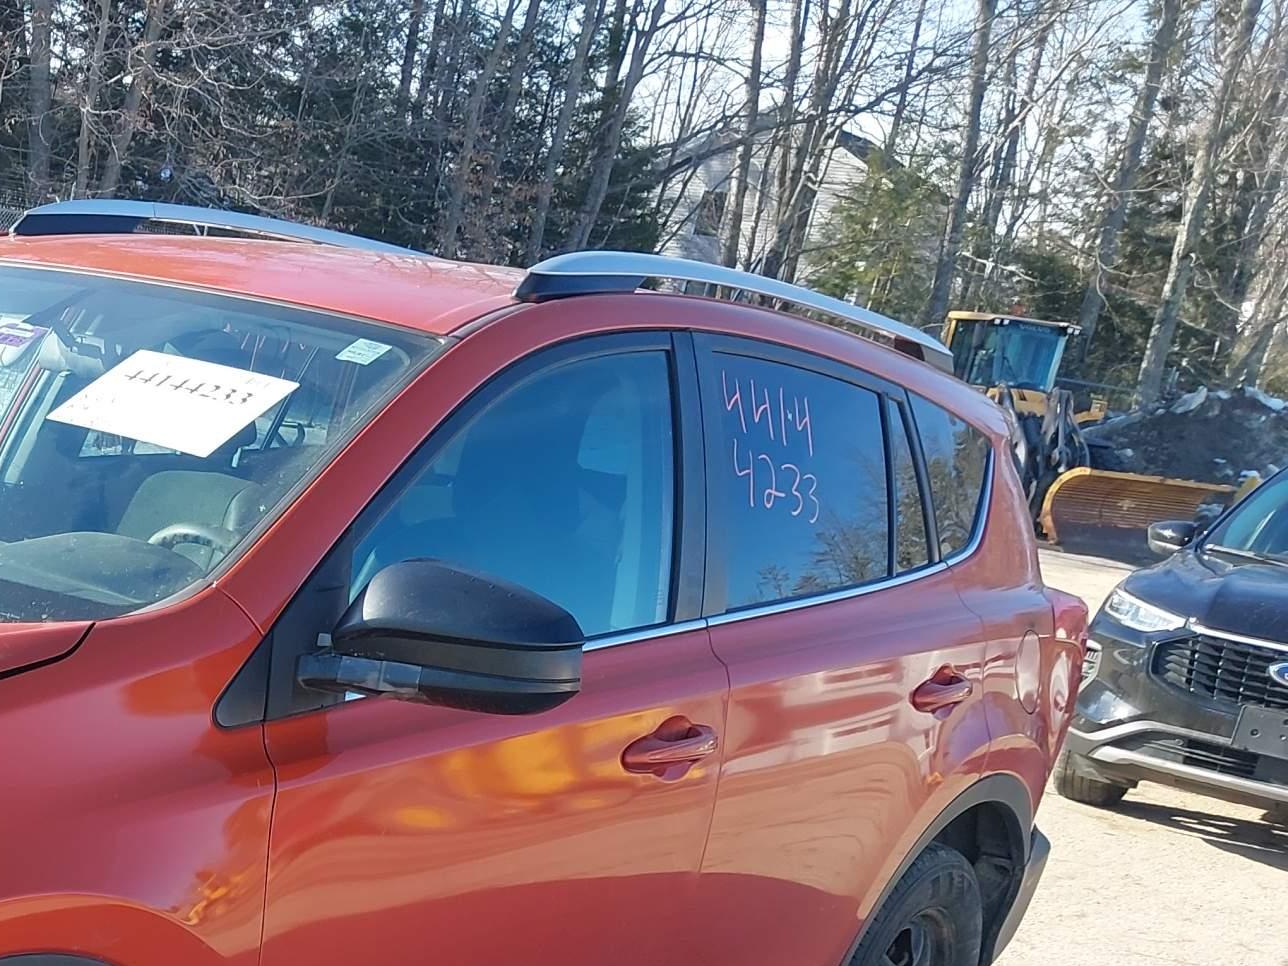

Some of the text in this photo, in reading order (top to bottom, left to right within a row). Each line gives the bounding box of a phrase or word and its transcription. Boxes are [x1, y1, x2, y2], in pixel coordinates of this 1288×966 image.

[124, 369, 253, 405] 44144233
[722, 369, 813, 457] 4414
[733, 438, 820, 524] 4233
